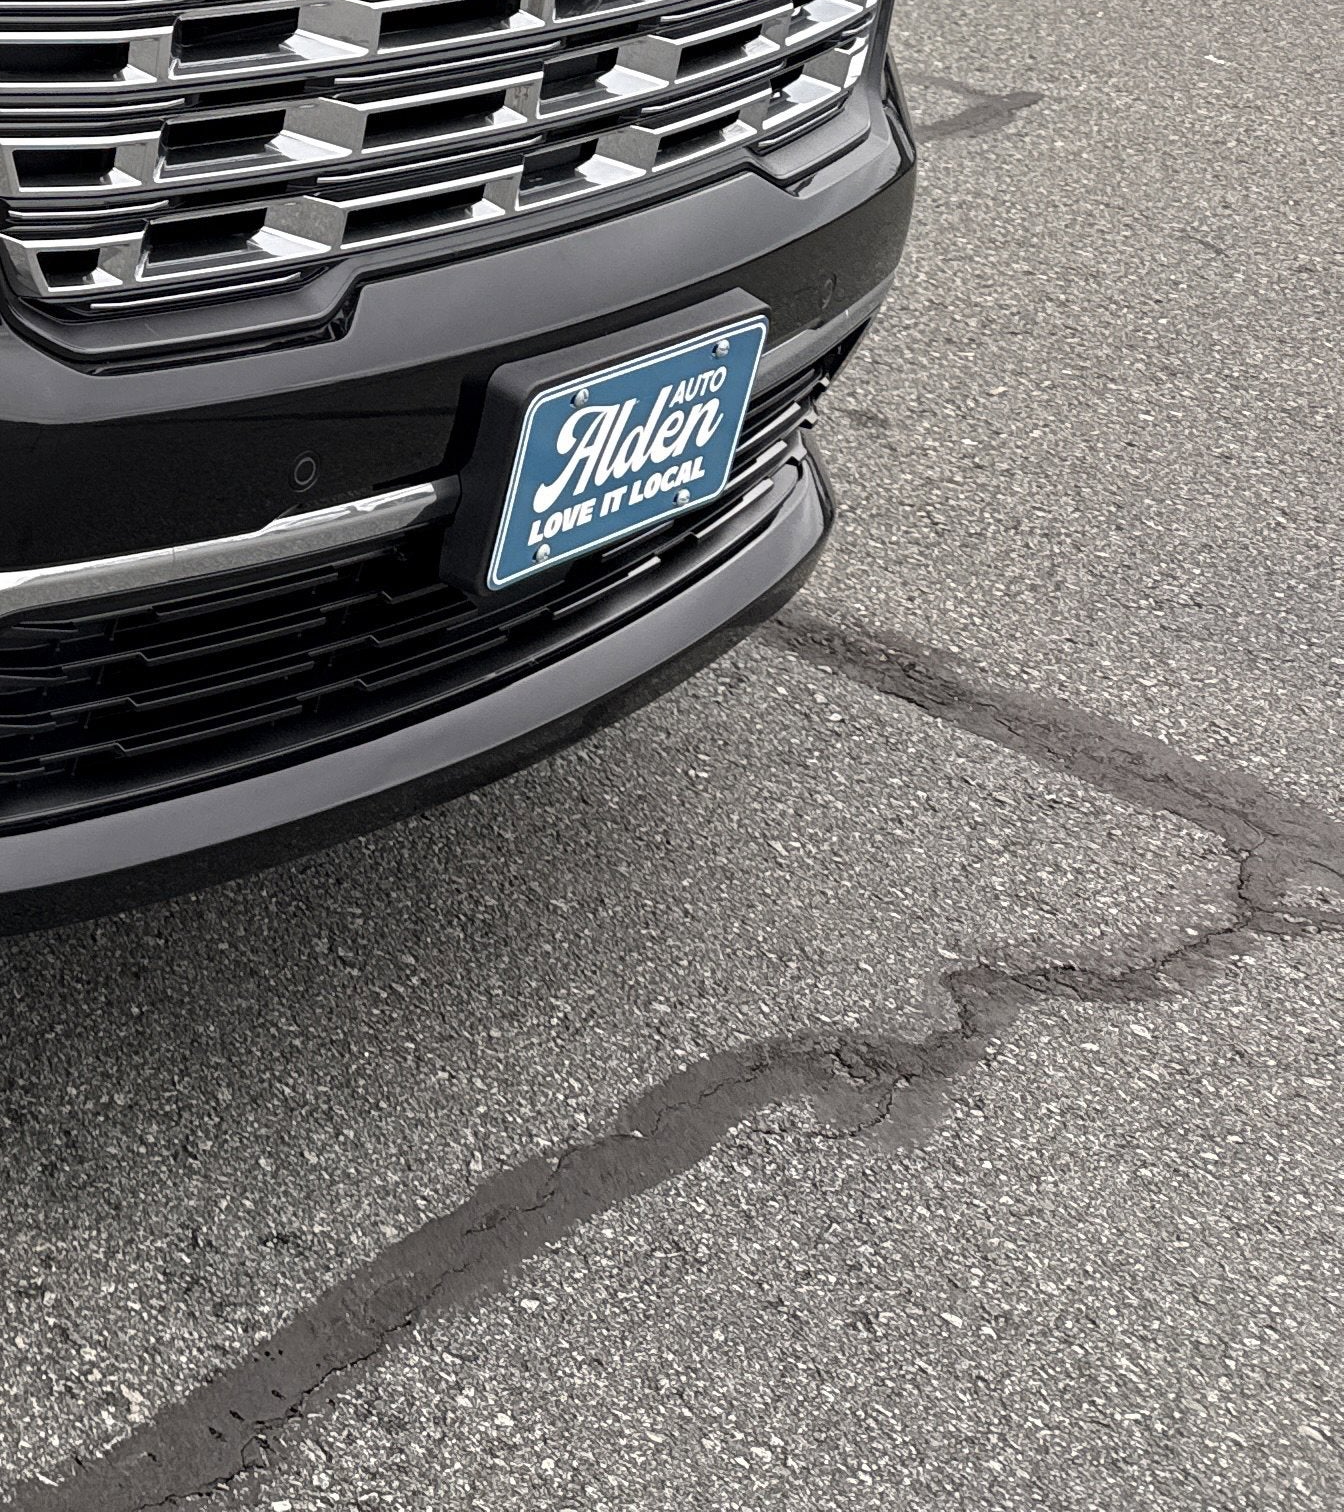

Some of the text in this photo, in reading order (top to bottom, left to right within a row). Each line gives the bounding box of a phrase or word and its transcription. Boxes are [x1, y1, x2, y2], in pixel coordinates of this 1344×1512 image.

[668, 366, 727, 408] AUTO
[533, 385, 724, 514] Alden
[527, 456, 705, 546] LOVE IT LOCAL
